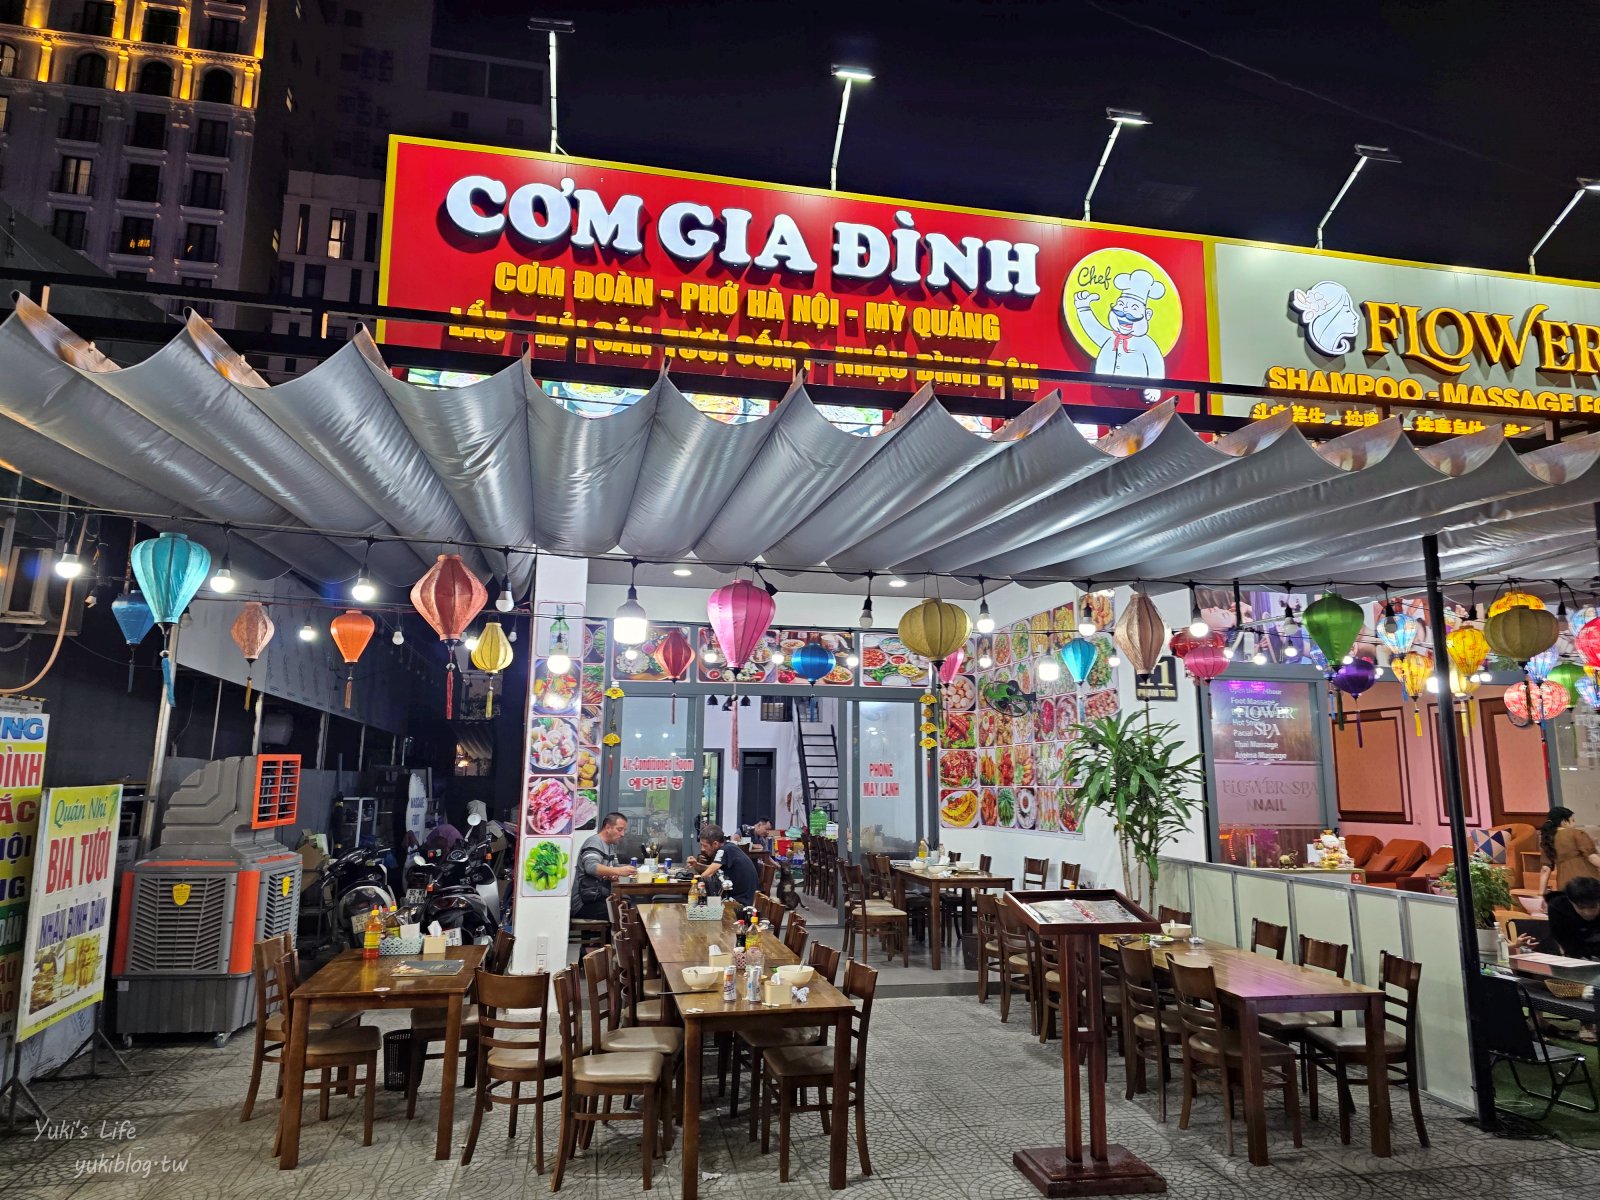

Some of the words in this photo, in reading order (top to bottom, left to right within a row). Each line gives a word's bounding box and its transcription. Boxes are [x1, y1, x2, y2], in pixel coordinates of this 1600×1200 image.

[446, 175, 643, 253] CƠM
[658, 202, 818, 273] GIA
[833, 210, 1041, 295] ĐÌNH
[494, 261, 564, 299] CƠM
[573, 270, 654, 306] ĐOÀN
[681, 280, 740, 315] PHỞ
[747, 287, 785, 321] HÀ
[792, 293, 840, 330] NỘI
[912, 304, 1000, 341] QUẢNG
[1077, 266, 1111, 290] Chef
[1363, 300, 1600, 374] FLOWER
[1268, 366, 1424, 400] SHAMPOO
[1443, 382, 1575, 412] MASSAGE
[0, 715, 44, 740] NG
[45, 836, 75, 894] BIA
[78, 826, 112, 885] TƯƠI
